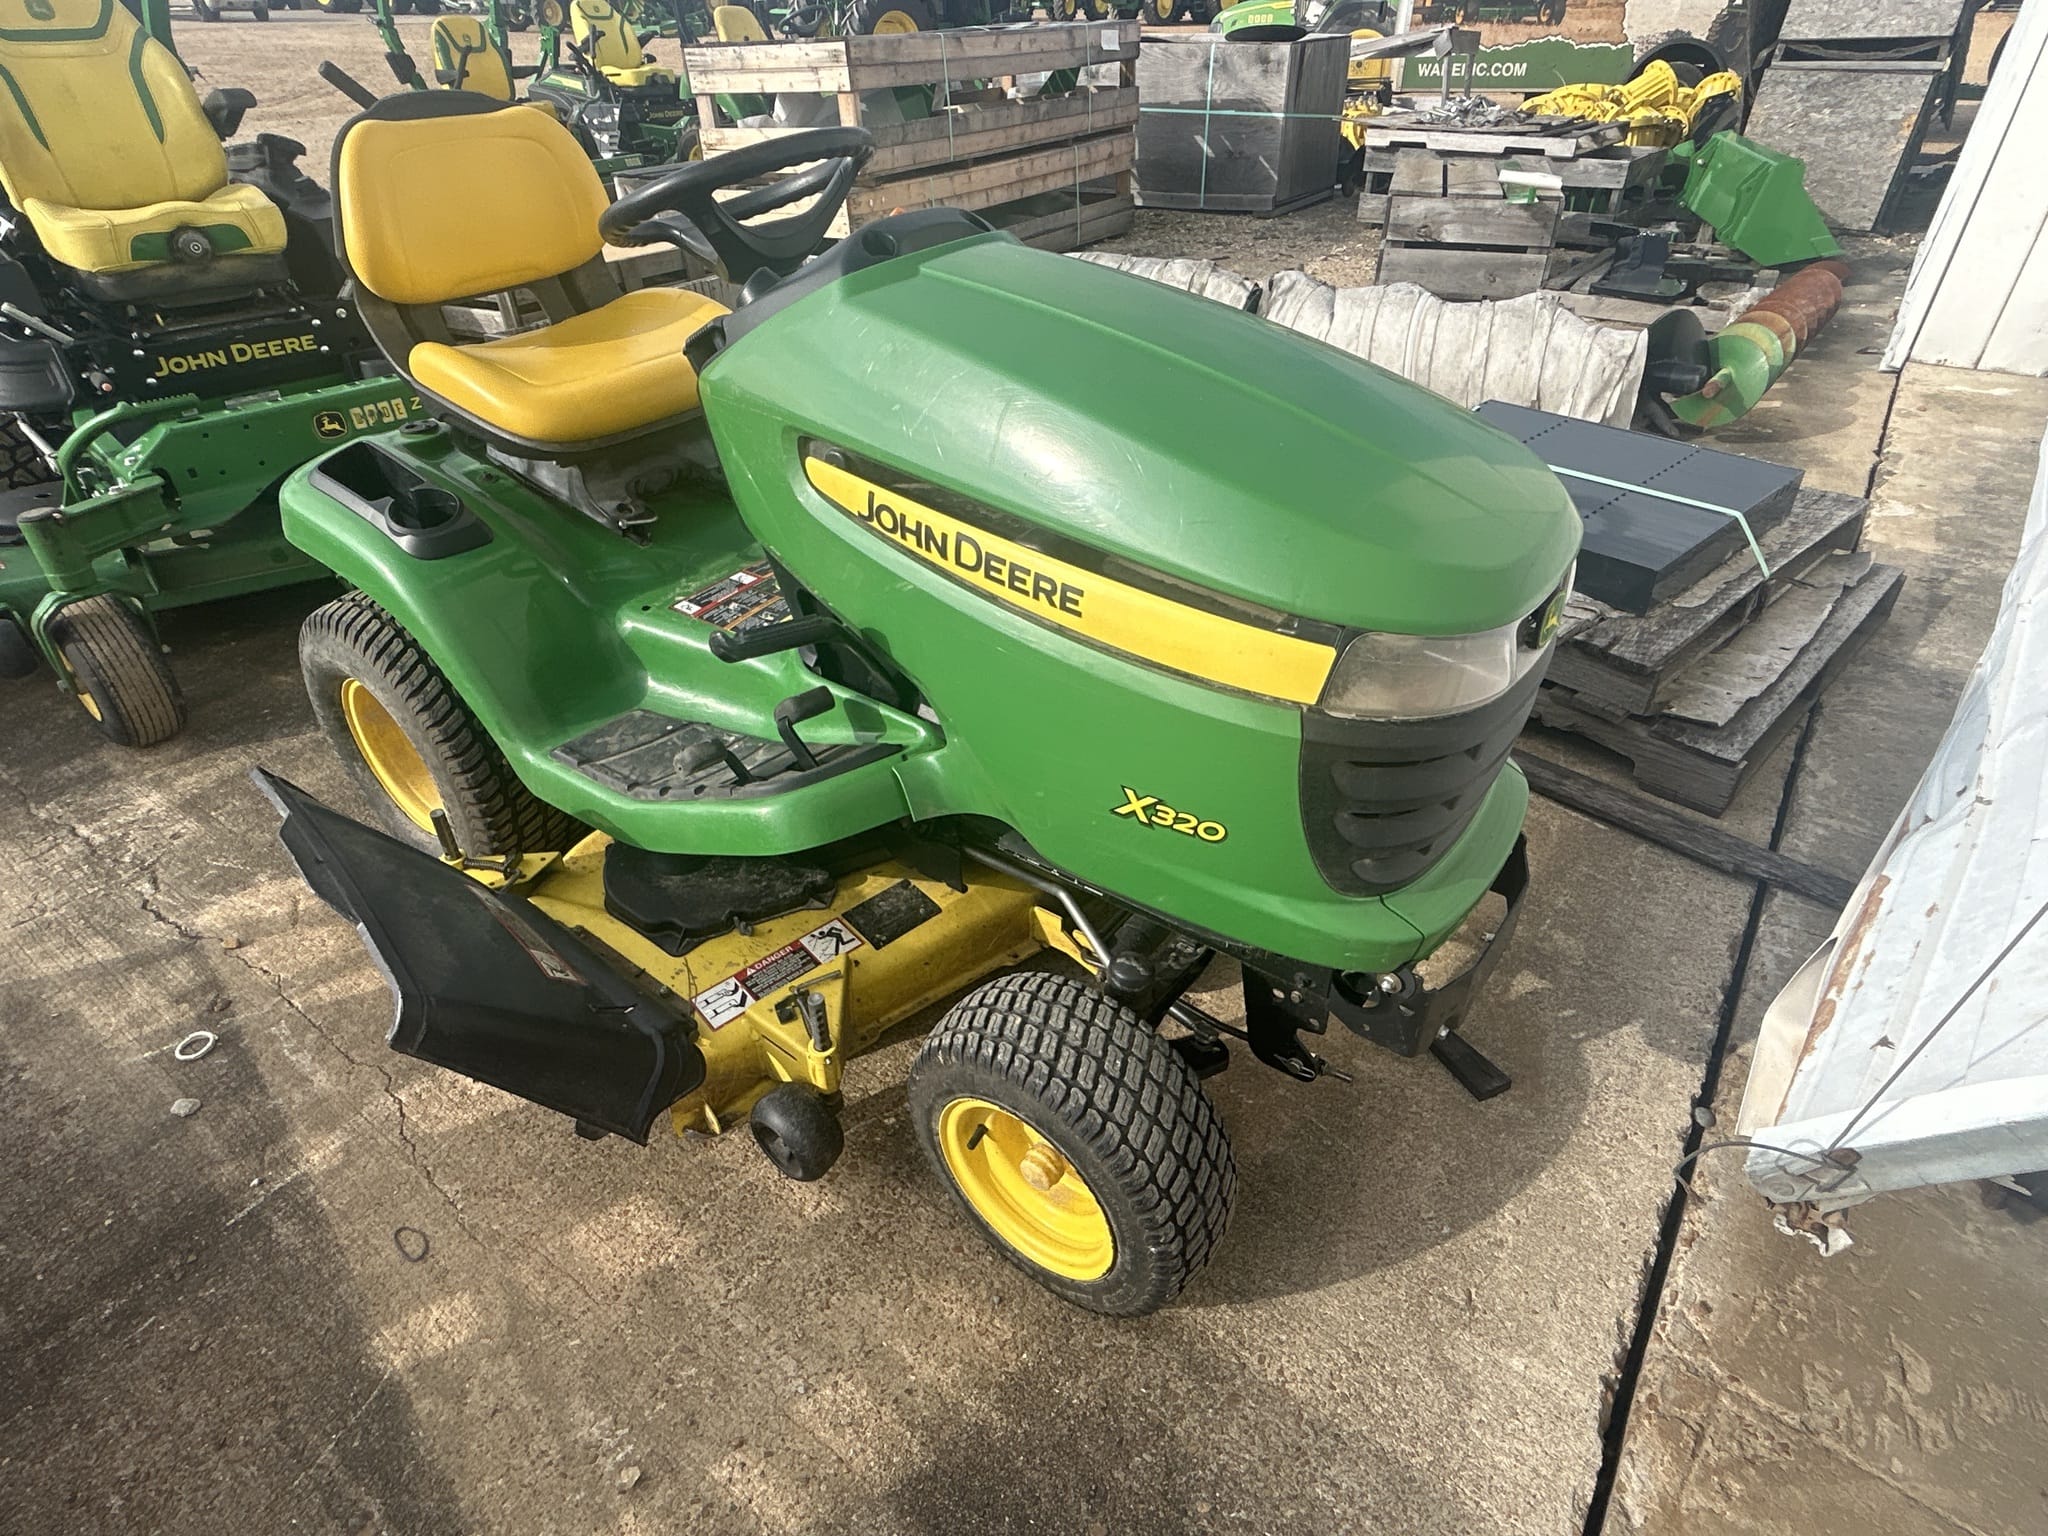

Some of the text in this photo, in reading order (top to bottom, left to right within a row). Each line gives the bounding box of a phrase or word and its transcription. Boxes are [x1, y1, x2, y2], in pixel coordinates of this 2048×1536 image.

[1418, 62, 1528, 77] WAEIC.COM
[155, 334, 318, 378] JOHN DEERE
[856, 491, 1085, 618] JOHN DEERE
[1110, 785, 1228, 843] X320
[754, 945, 794, 970] DANGER
